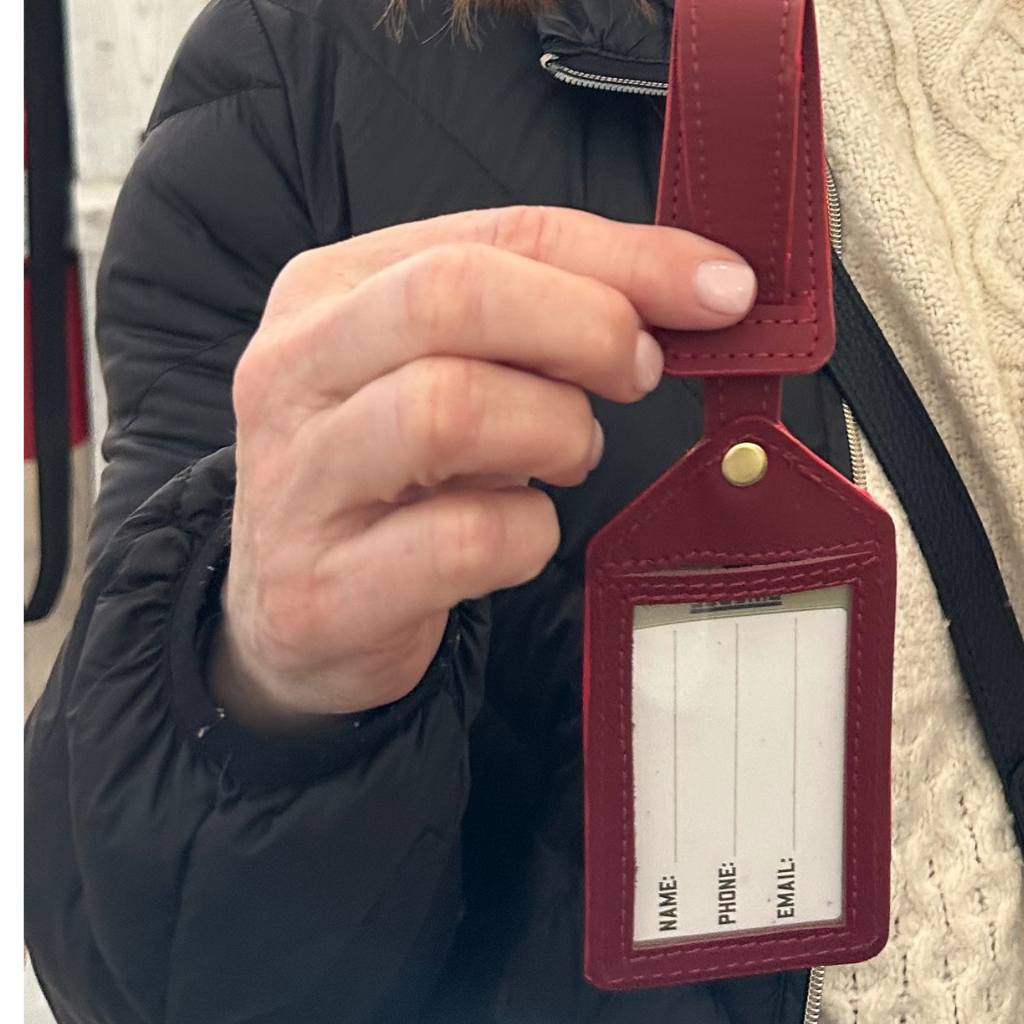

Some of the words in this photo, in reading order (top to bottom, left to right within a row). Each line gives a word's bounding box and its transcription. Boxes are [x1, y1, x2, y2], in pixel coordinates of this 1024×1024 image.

[659, 875, 678, 932] NAME:
[718, 862, 736, 925] PHONE:
[777, 857, 796, 920] EMAIL:
